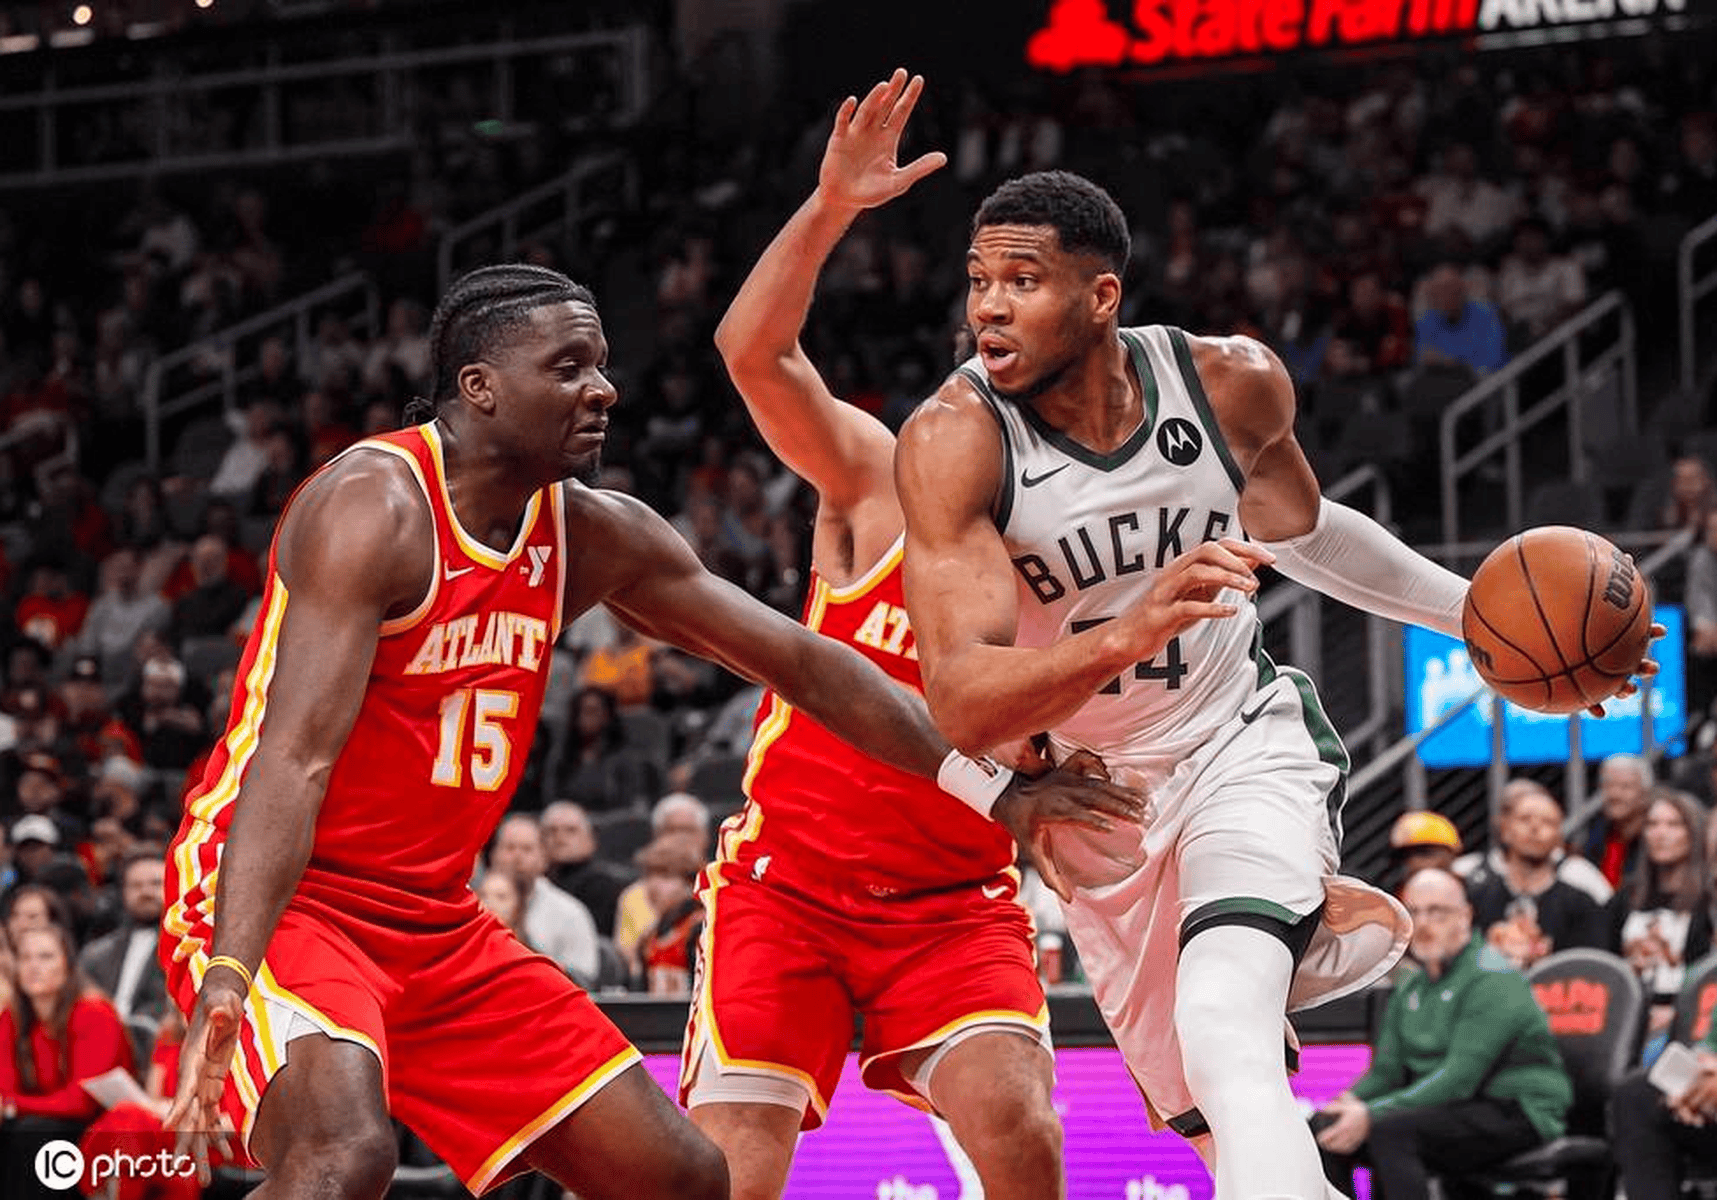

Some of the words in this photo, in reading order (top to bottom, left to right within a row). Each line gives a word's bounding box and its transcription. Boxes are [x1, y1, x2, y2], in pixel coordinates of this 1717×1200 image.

[1133, 0, 1301, 63] State
[402, 611, 548, 675] ATLANT
[430, 687, 520, 792] 15
